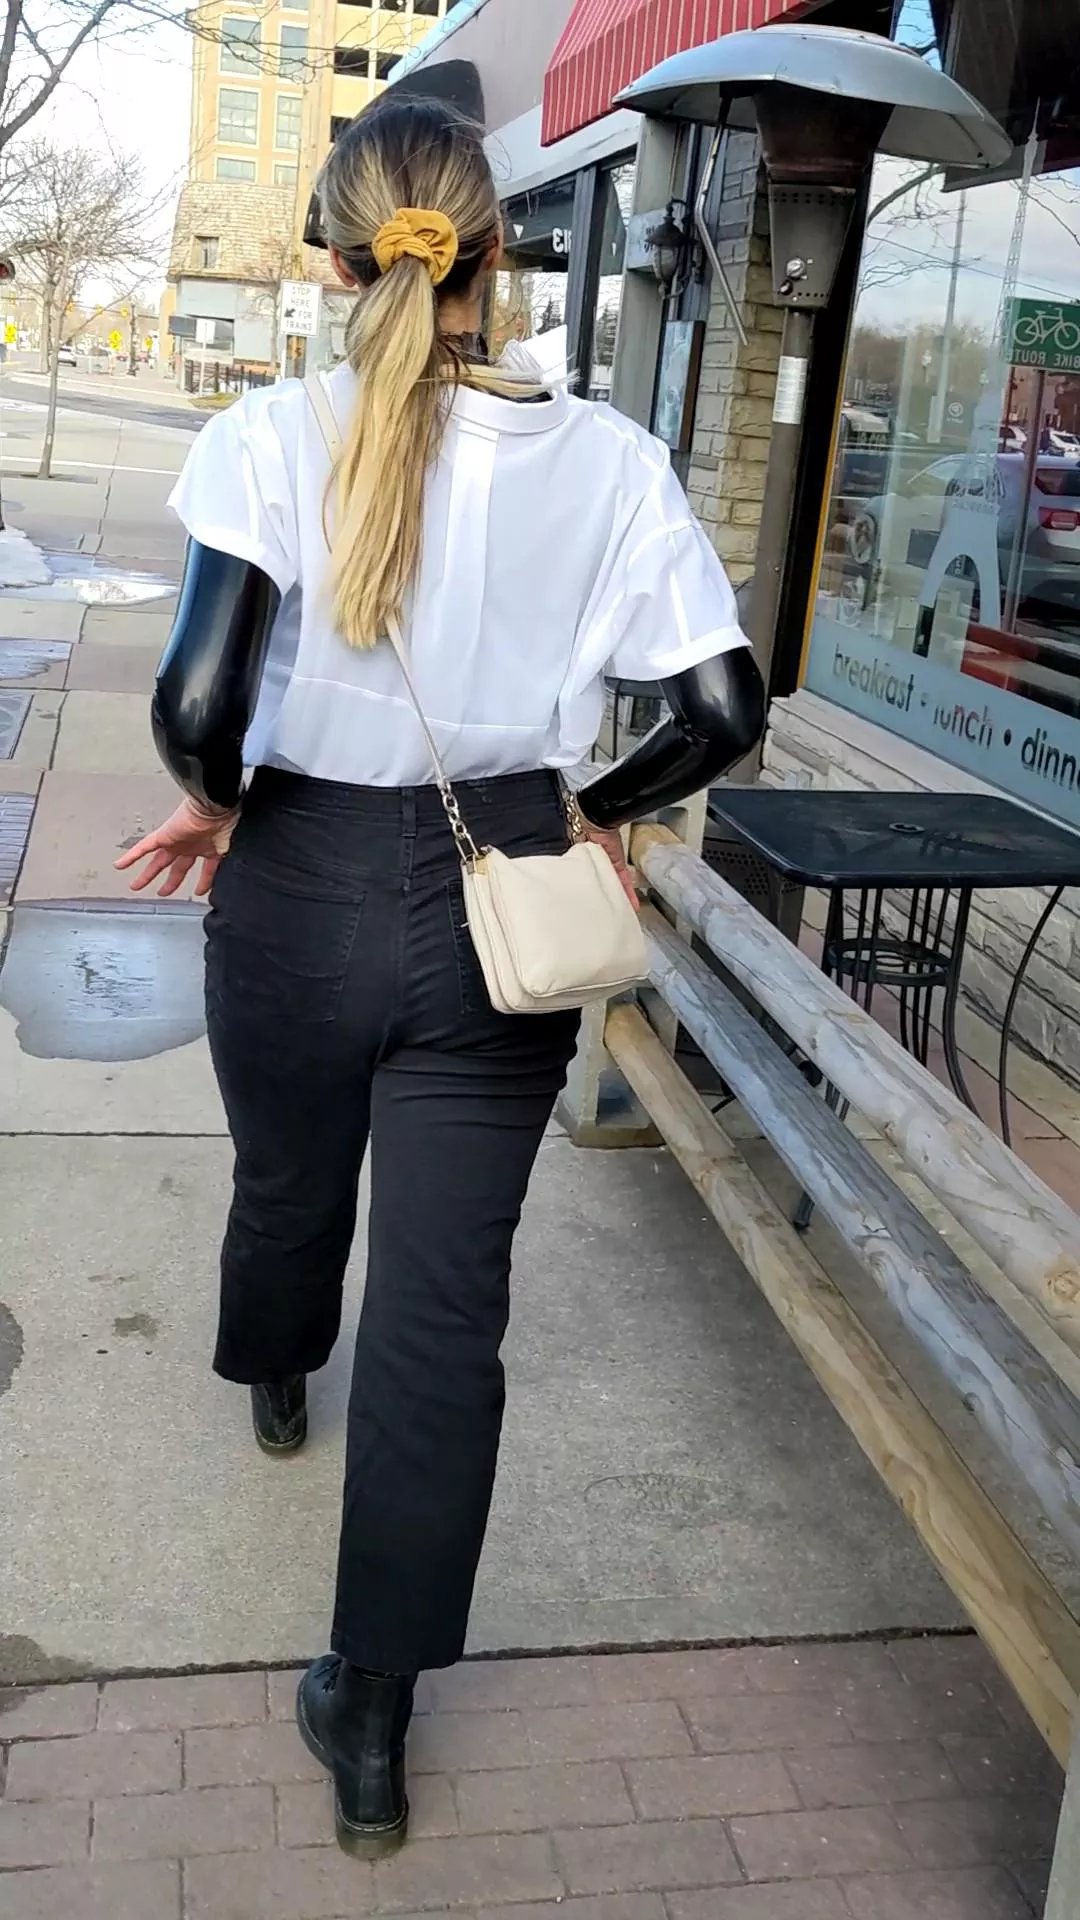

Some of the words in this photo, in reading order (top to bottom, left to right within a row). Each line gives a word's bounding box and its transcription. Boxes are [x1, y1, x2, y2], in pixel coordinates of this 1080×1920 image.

[292, 286, 311, 296] STOP
[290, 298, 310, 308] HERE
[298, 310, 312, 319] FOR
[286, 319, 312, 331] TRAINS
[832, 643, 915, 712] breakfast
[932, 700, 993, 750] lunch
[1020, 727, 1080, 790] dinn
